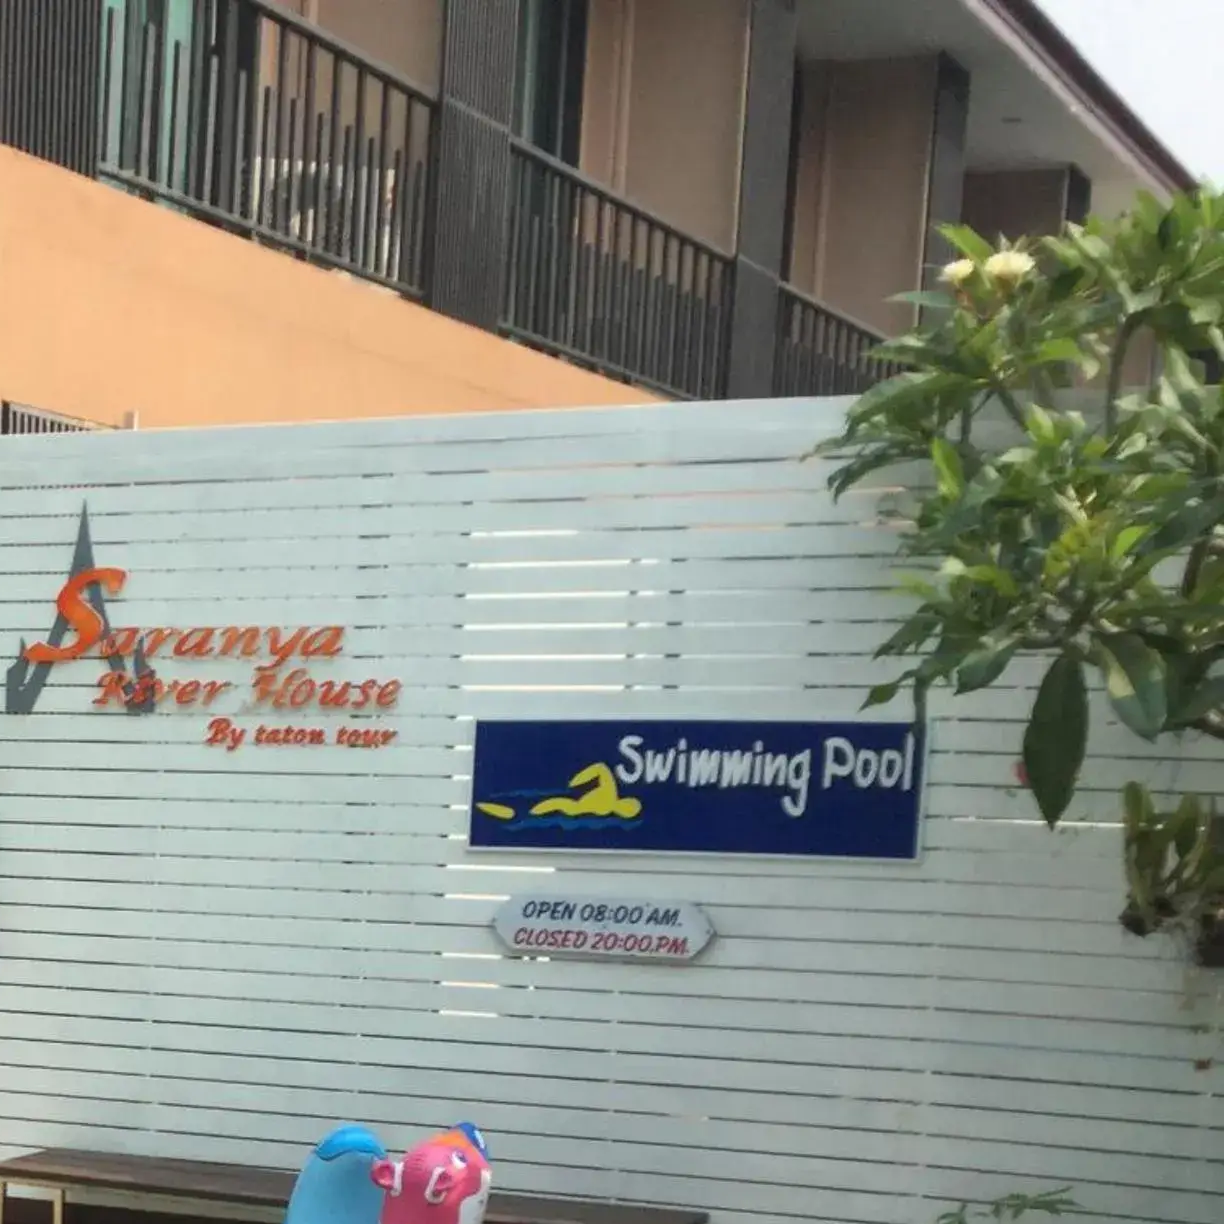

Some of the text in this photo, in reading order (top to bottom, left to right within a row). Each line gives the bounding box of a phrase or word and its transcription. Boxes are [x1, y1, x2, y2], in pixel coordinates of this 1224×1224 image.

[24, 566, 346, 671] Saranya
[91, 667, 403, 709] River House
[205, 717, 398, 751] By taton tour
[614, 732, 914, 818] Swimming Pool
[522, 900, 684, 928] OPEN 08:00 AM.
[513, 927, 588, 950] CLOSED
